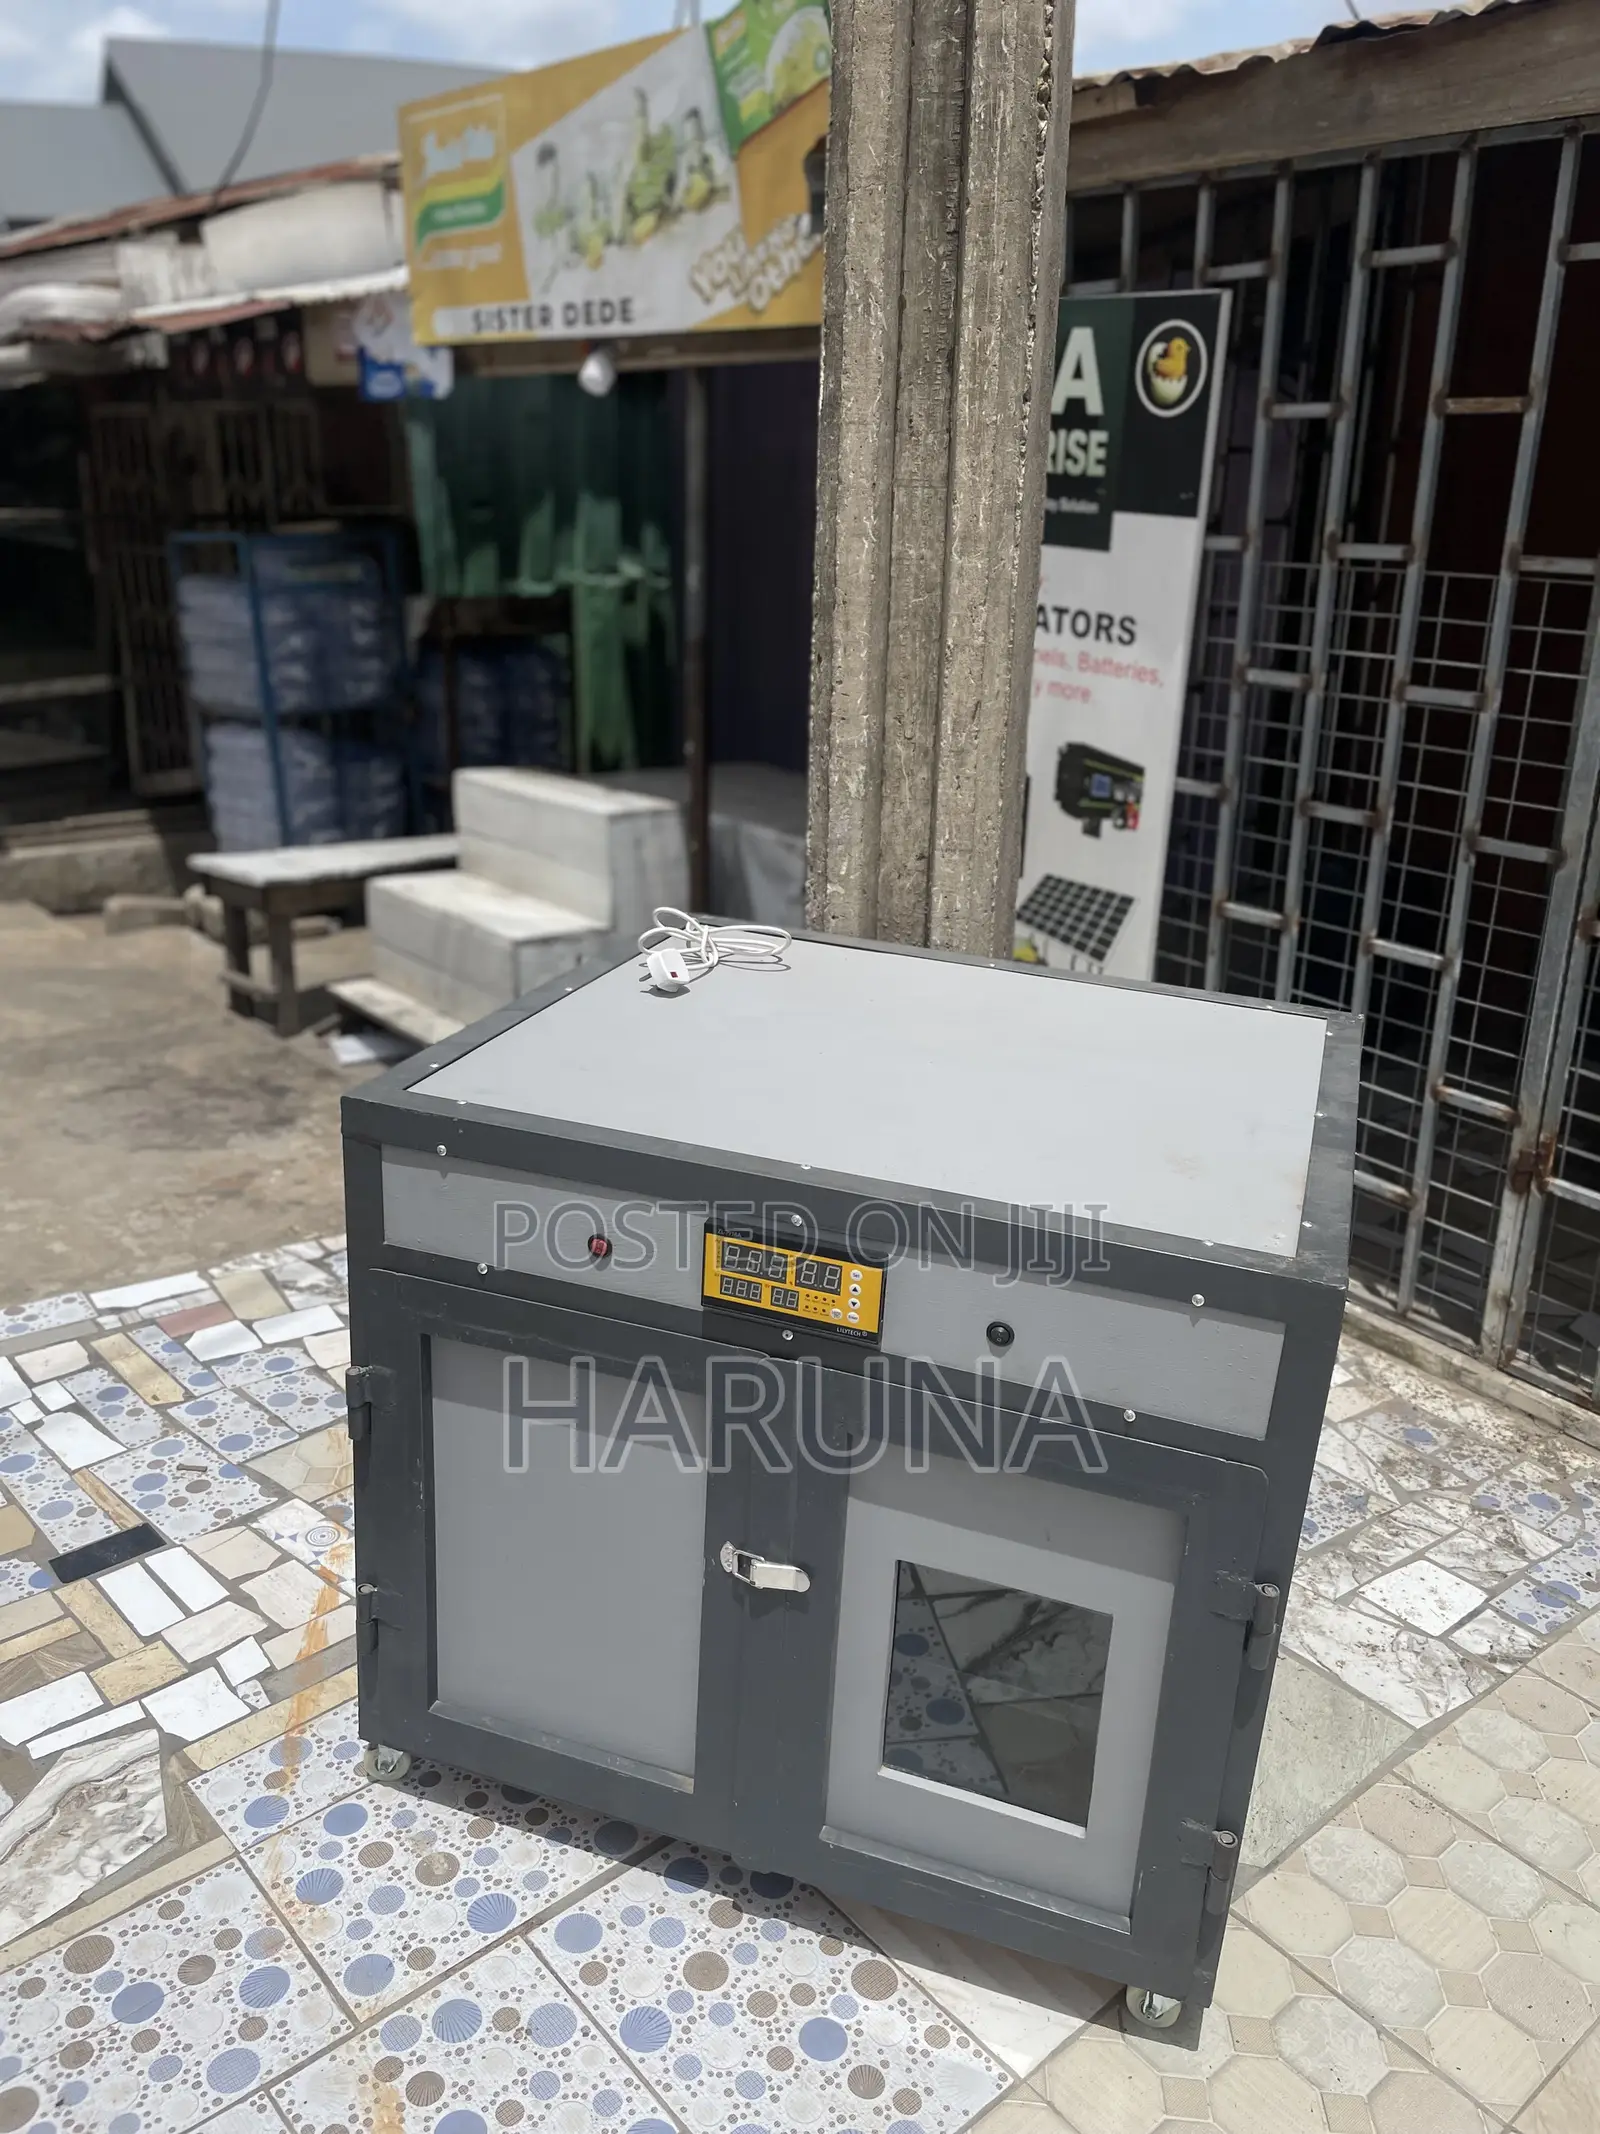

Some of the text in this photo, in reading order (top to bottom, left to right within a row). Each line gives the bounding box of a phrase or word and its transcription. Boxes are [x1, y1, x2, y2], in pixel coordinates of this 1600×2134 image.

[472, 297, 636, 334] SISTER DEDE
[836, 1326, 862, 1337] LILYTECH
